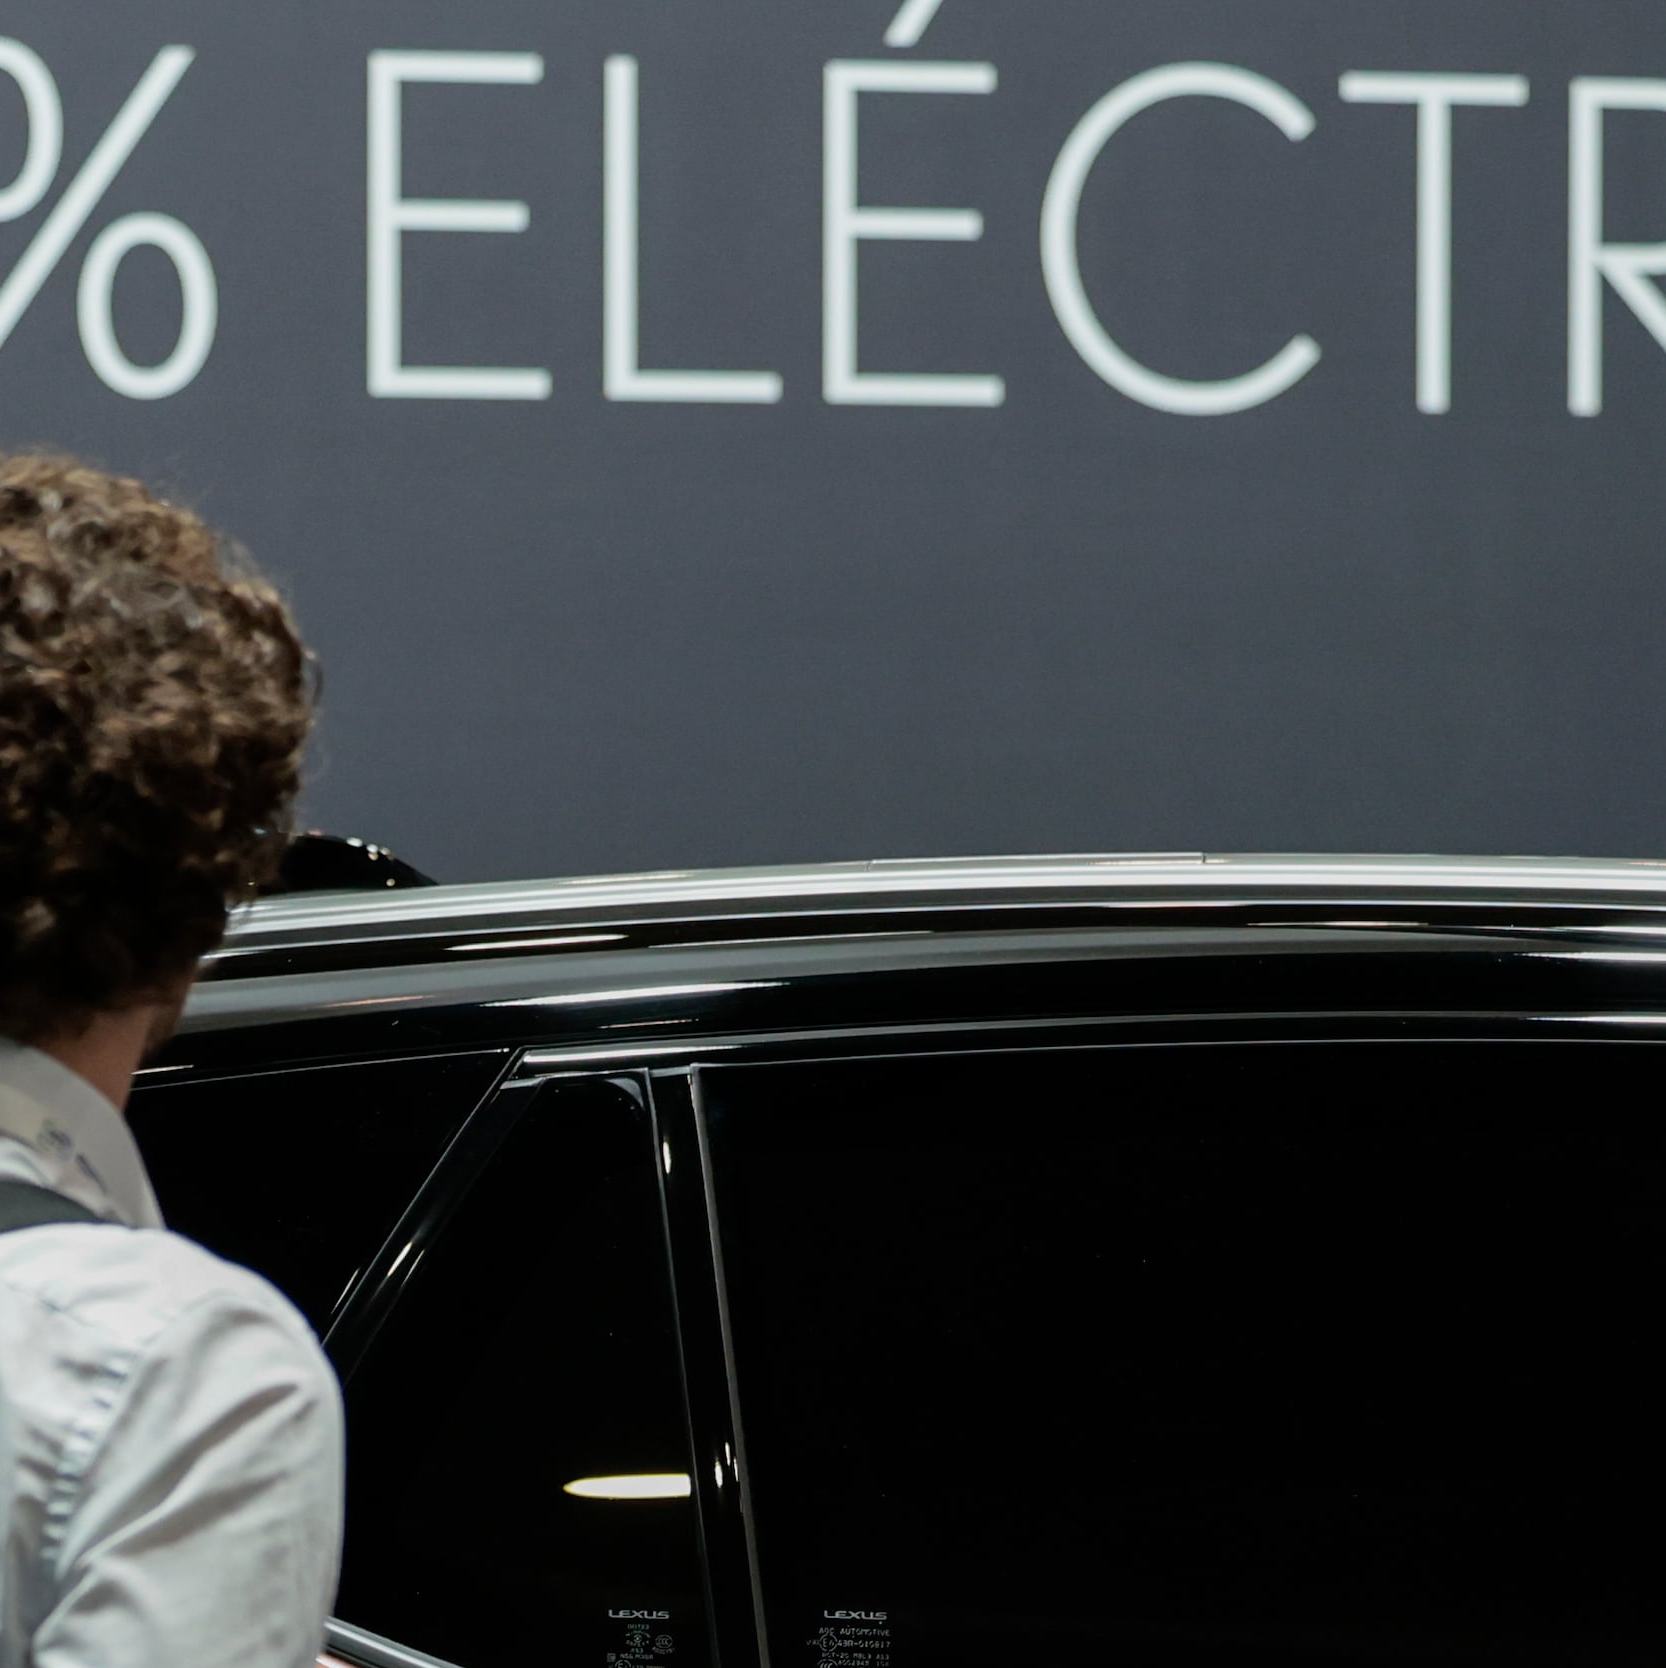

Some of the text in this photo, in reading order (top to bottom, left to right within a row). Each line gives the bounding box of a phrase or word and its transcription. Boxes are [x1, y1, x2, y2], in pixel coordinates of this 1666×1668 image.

[607, 1608, 670, 1620] LEXUS
[823, 1609, 888, 1621] LEXUS
[839, 1628, 891, 1637] AUTOMOTIVE
